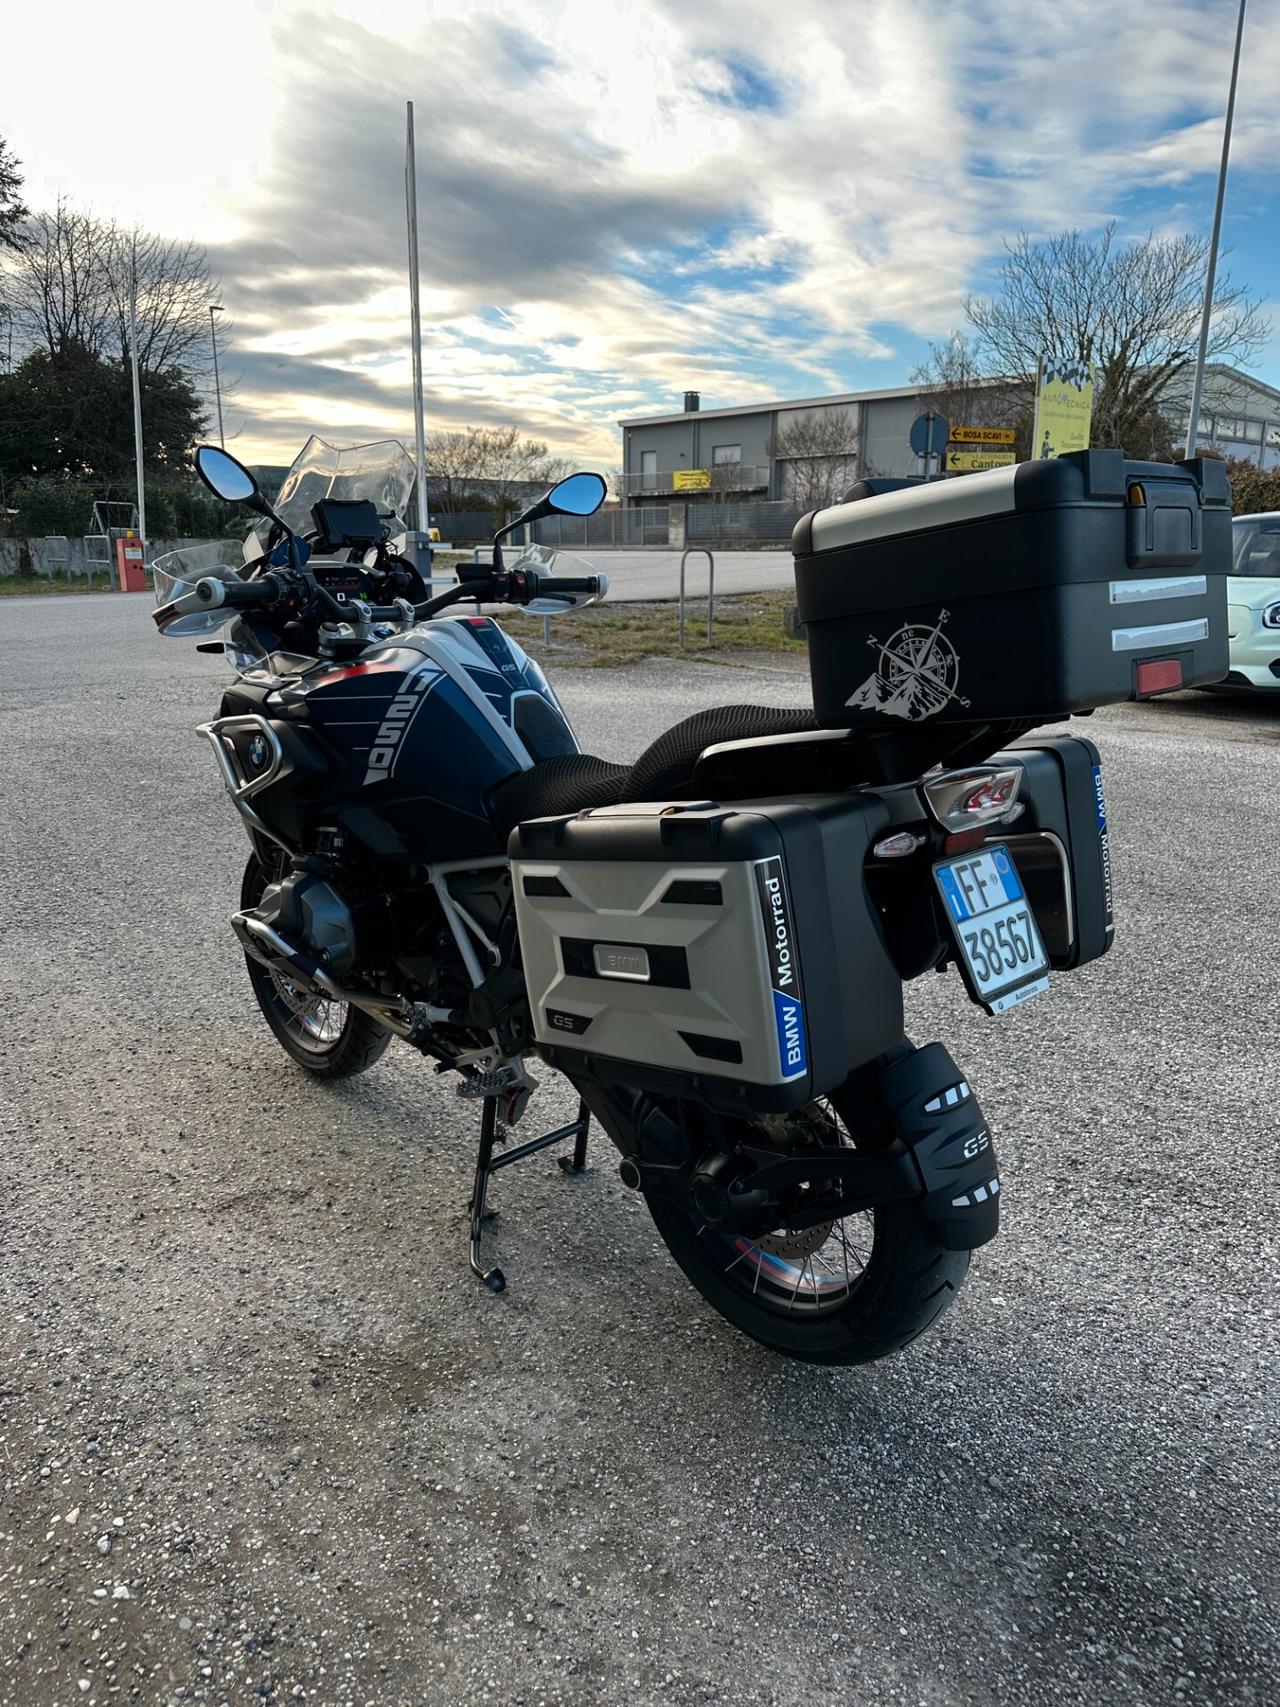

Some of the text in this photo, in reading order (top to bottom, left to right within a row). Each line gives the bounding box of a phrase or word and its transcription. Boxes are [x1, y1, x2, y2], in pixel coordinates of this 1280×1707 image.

[963, 430, 1002, 440] BOSA SCAVI
[368, 670, 441, 769] 1250
[1094, 774, 1106, 818] BMW
[955, 860, 989, 913] FF
[964, 910, 1036, 982] 38567
[765, 877, 802, 1066] BMW Motorrad
[553, 1014, 574, 1029] GS
[963, 1130, 989, 1159] GS
